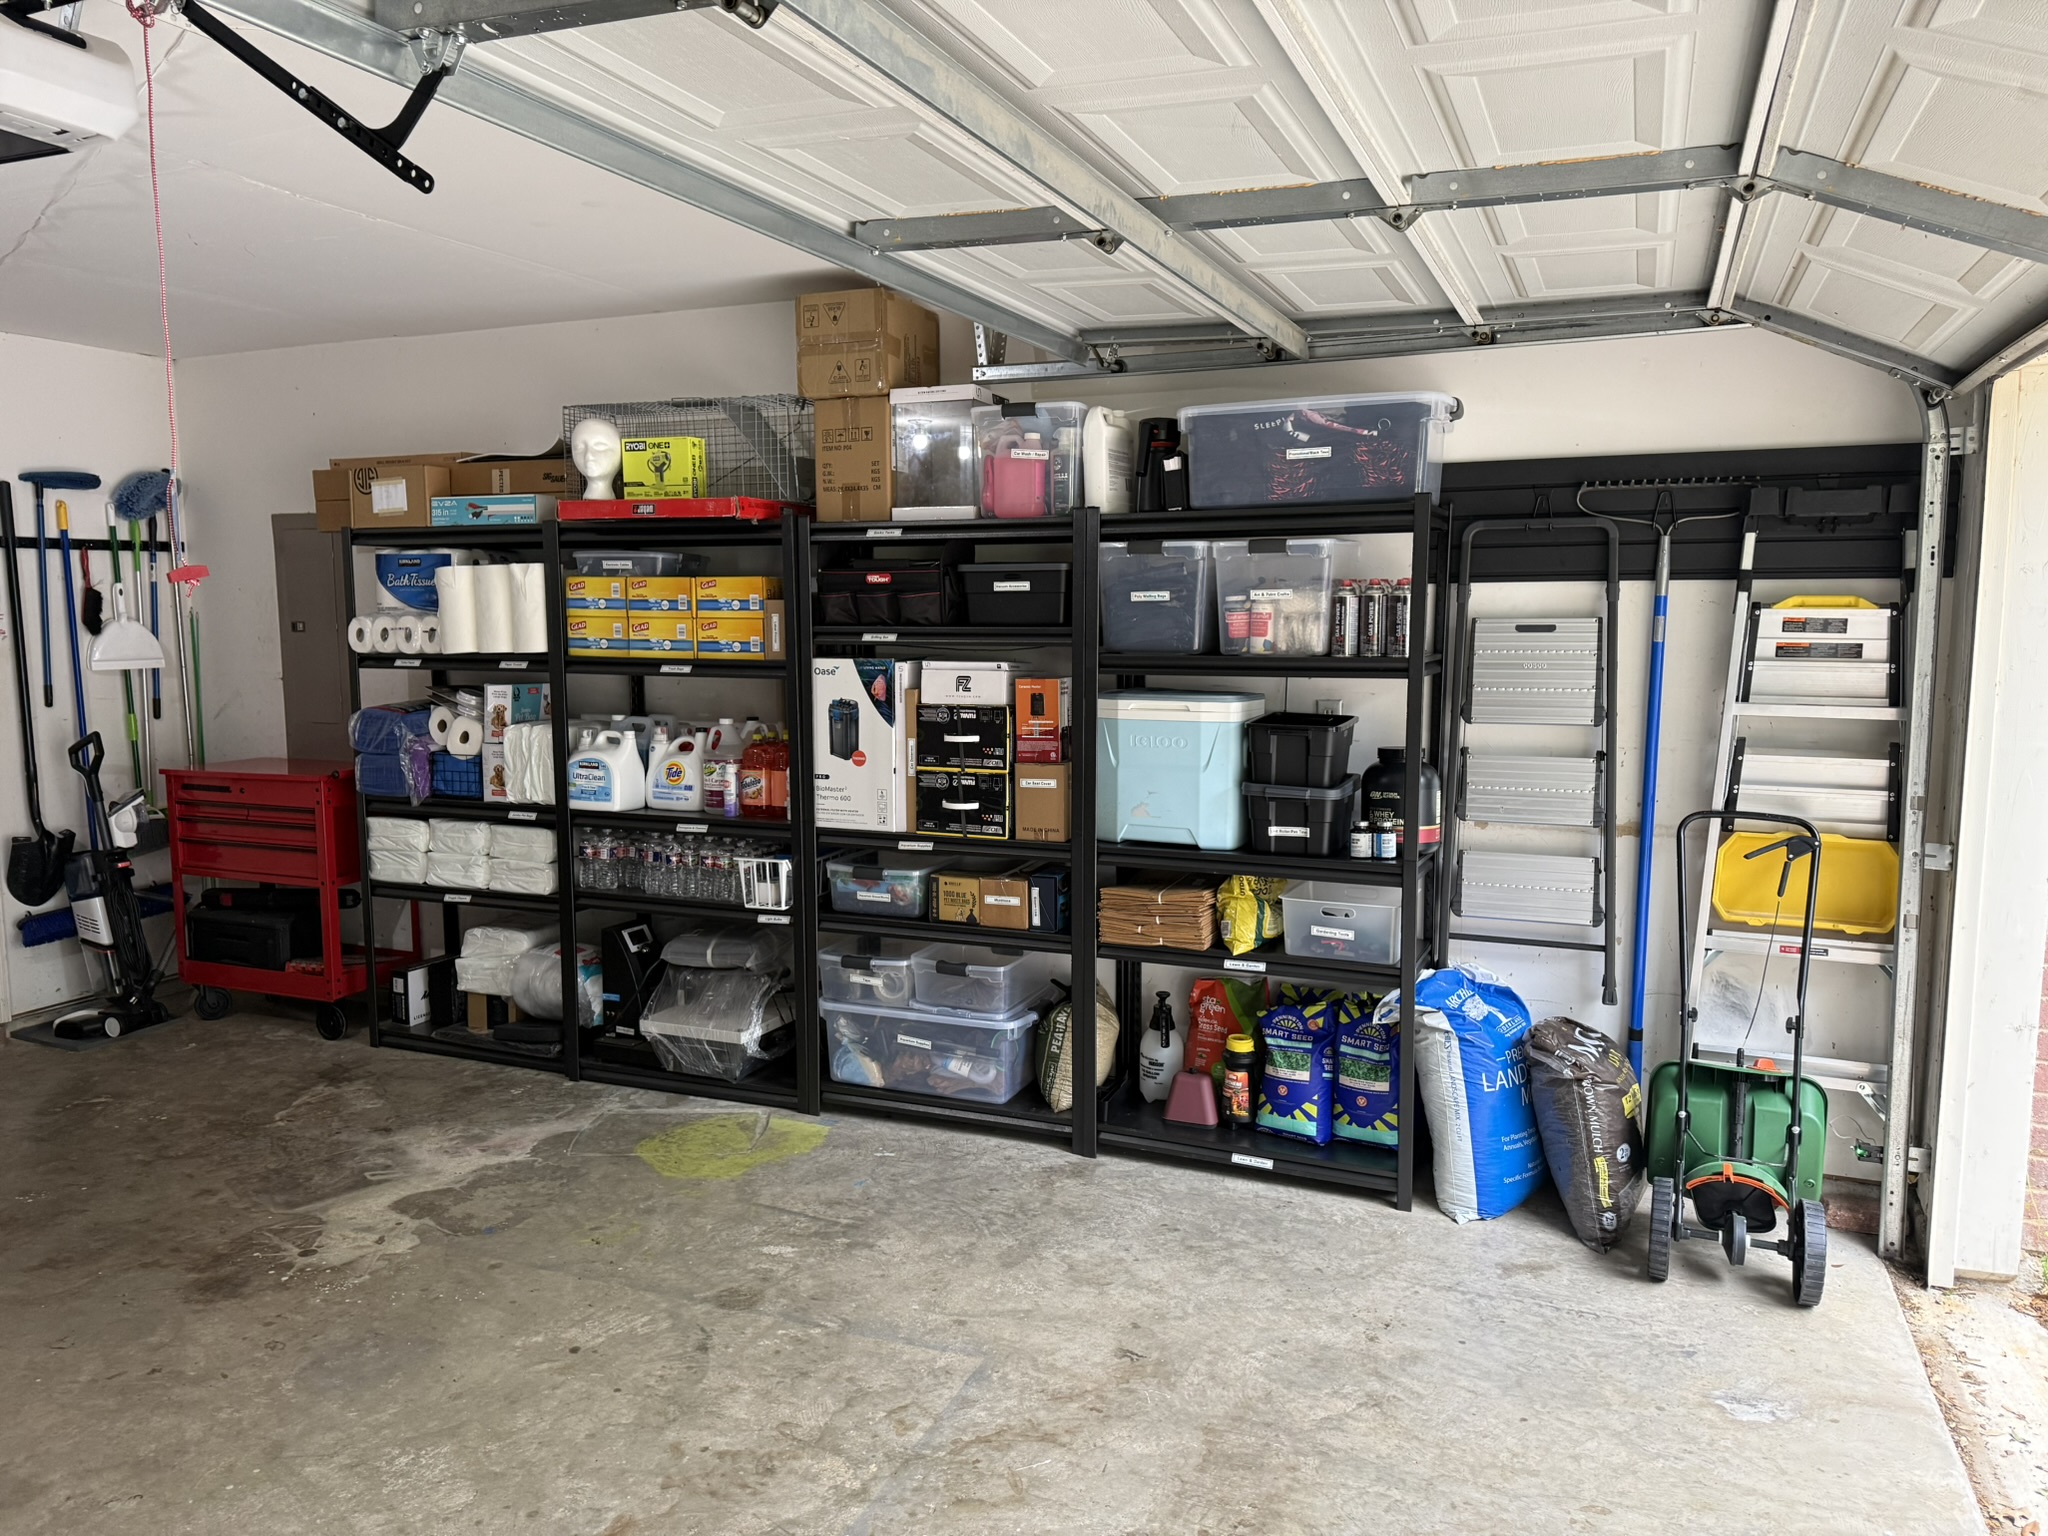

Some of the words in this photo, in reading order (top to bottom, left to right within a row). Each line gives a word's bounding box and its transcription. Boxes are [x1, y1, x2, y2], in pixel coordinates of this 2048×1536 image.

[626, 442, 646, 450] RYOBI
[387, 573, 409, 587] Bath
[410, 574, 437, 586] Tissue
[814, 667, 836, 676] Oase
[1130, 735, 1188, 748] IGLOO
[573, 773, 605, 781] UltraClean
[666, 767, 683, 780] Tide
[1203, 995, 1216, 1003] sta
[1200, 1002, 1225, 1014] green
[1272, 1015, 1304, 1030] PENNINGTON
[1214, 1025, 1227, 1034] Seed
[1262, 1028, 1289, 1038] SMART
[1356, 1022, 1387, 1040] PENNINGTON
[1051, 1032, 1063, 1054] PEA
[1342, 1035, 1372, 1048] SMART
[1449, 1072, 1460, 1109] LANDSCAPE
[1582, 1078, 1597, 1115] ROWN
[1590, 1114, 1603, 1152] MULCH
[1510, 1130, 1528, 1140] Planting
[1504, 1142, 1524, 1151] Annuals,
[1504, 1174, 1522, 1184] Specific
